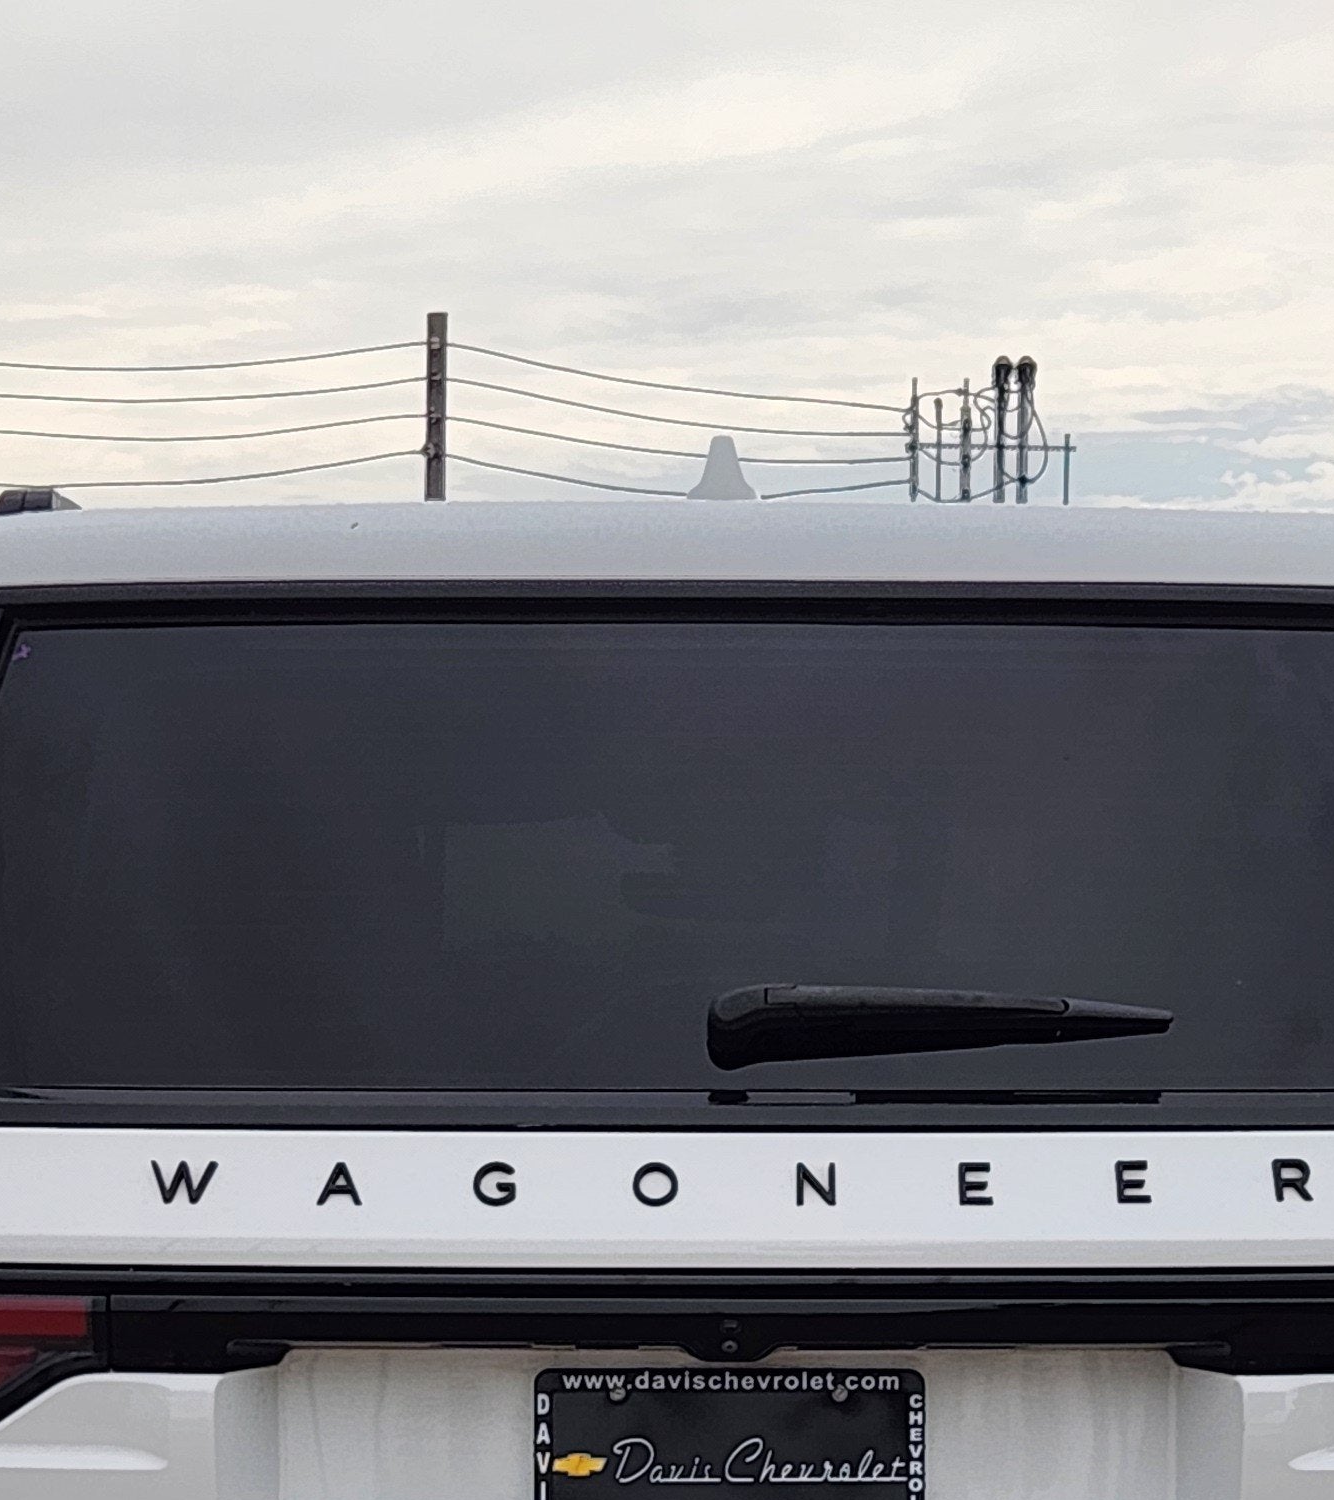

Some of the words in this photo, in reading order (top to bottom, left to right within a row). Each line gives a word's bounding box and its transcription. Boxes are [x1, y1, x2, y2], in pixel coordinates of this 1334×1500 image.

[150, 1158, 1314, 1207] WAGONEER
[562, 1371, 900, 1392] www.davischevrolet.com
[612, 1438, 722, 1484] Davis
[724, 1437, 909, 1484] Chevrolet
